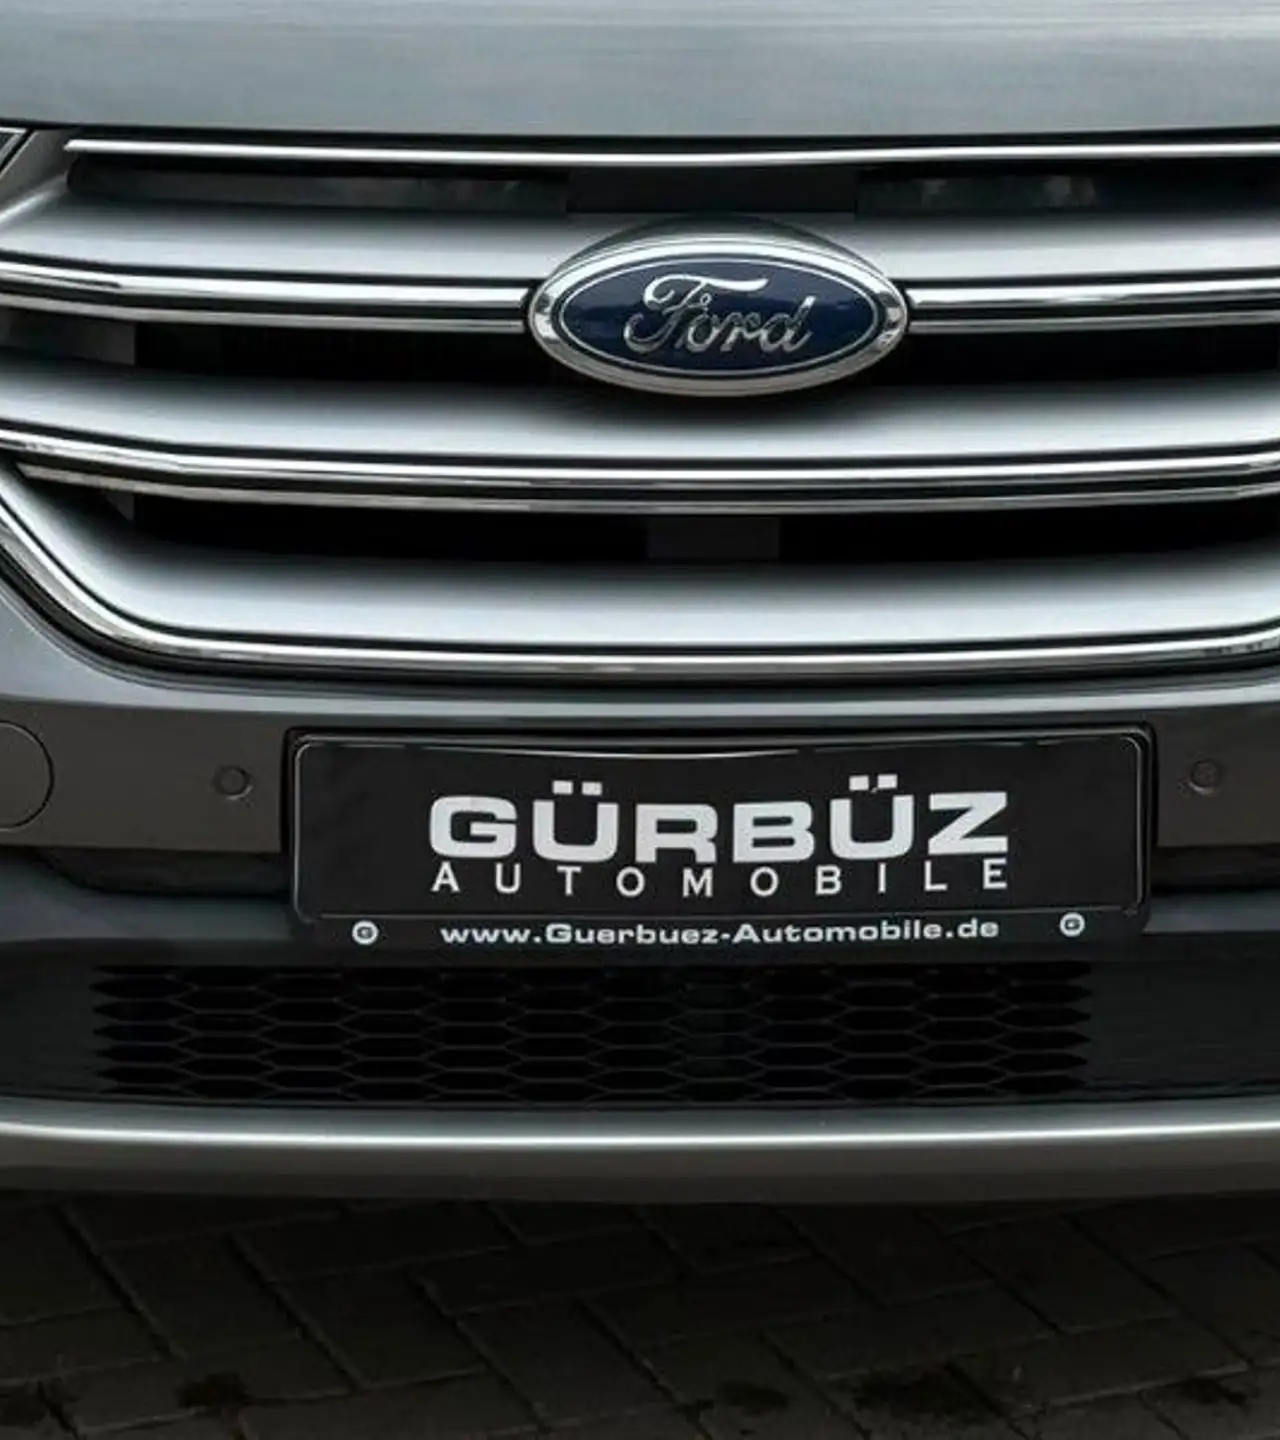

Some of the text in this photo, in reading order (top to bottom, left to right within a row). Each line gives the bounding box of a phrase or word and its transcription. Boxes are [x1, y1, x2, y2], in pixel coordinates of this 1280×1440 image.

[623, 273, 816, 353] Ford
[429, 774, 1009, 862] GÜRBÜZ
[431, 858, 1008, 897] AUTOMOBILE
[440, 918, 1000, 945] www.Guerbuez-Automobile.de
